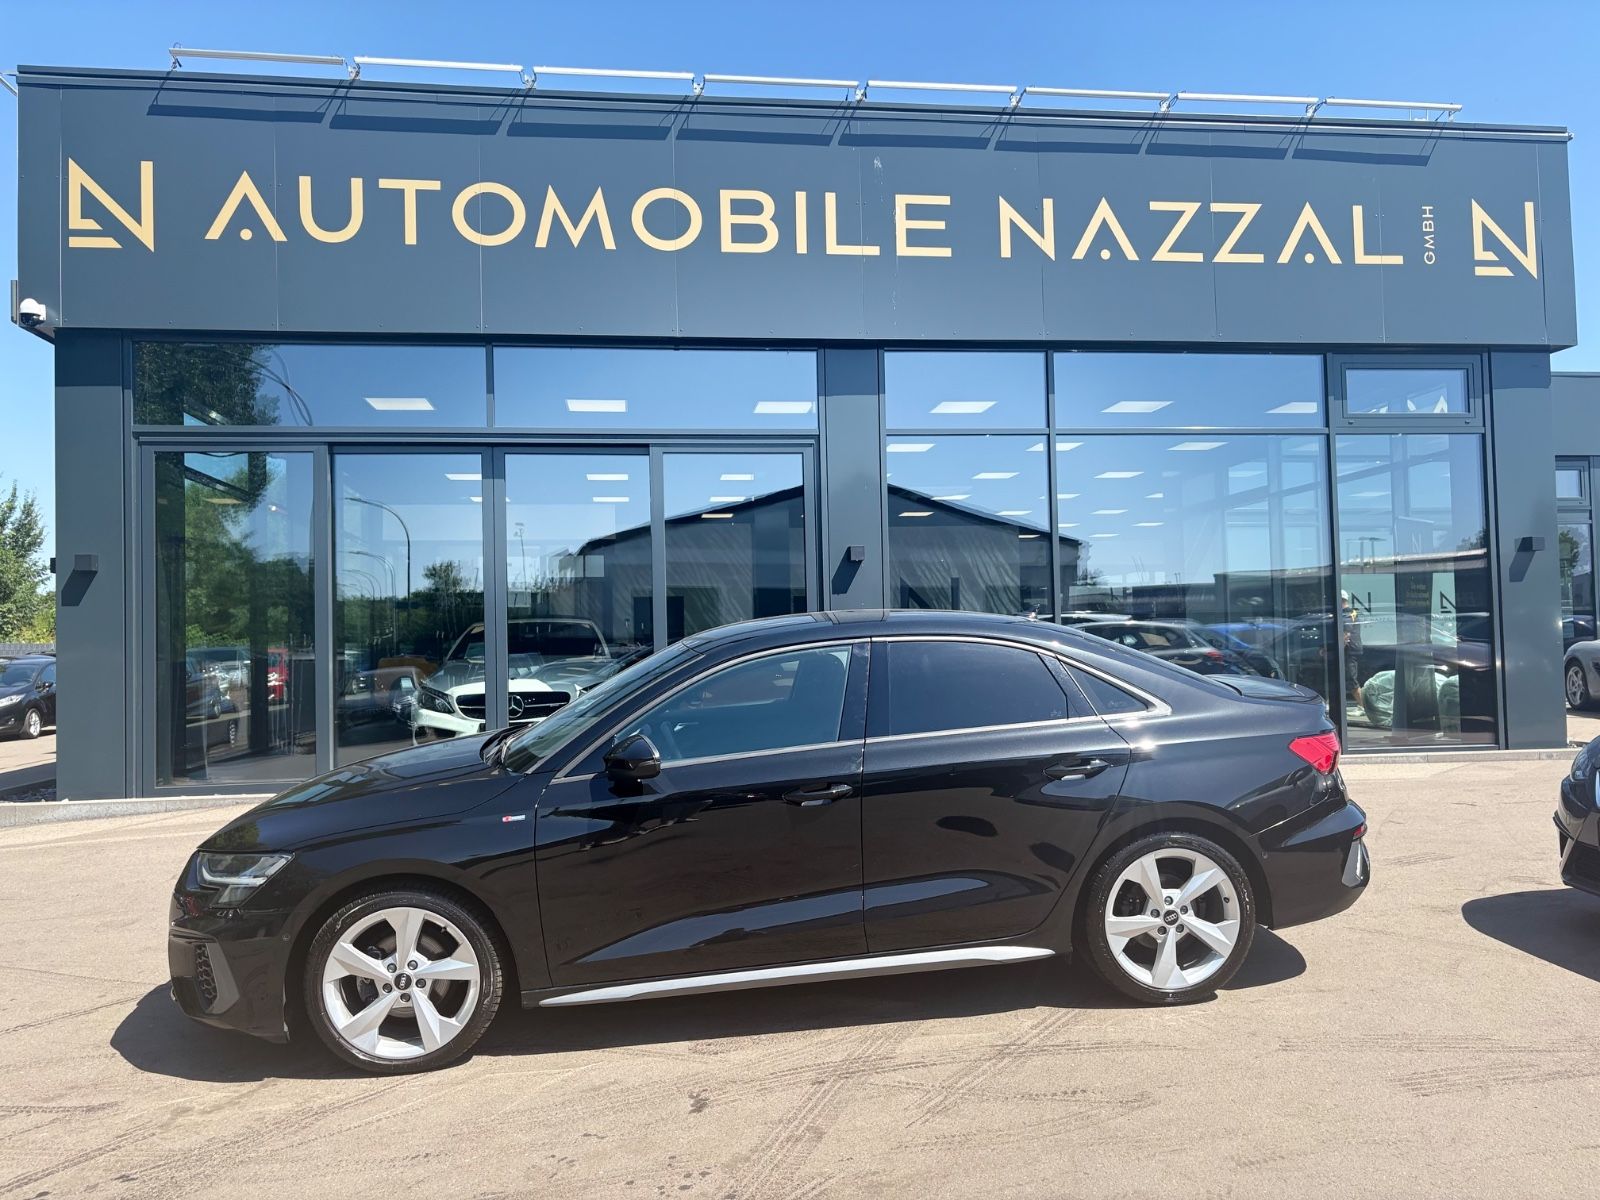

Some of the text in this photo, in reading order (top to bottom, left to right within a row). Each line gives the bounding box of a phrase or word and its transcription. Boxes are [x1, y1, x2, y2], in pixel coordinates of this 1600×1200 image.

[204, 171, 1404, 265] AUTOMOBILE NAZZAL
[1421, 205, 1436, 265] GMBH
